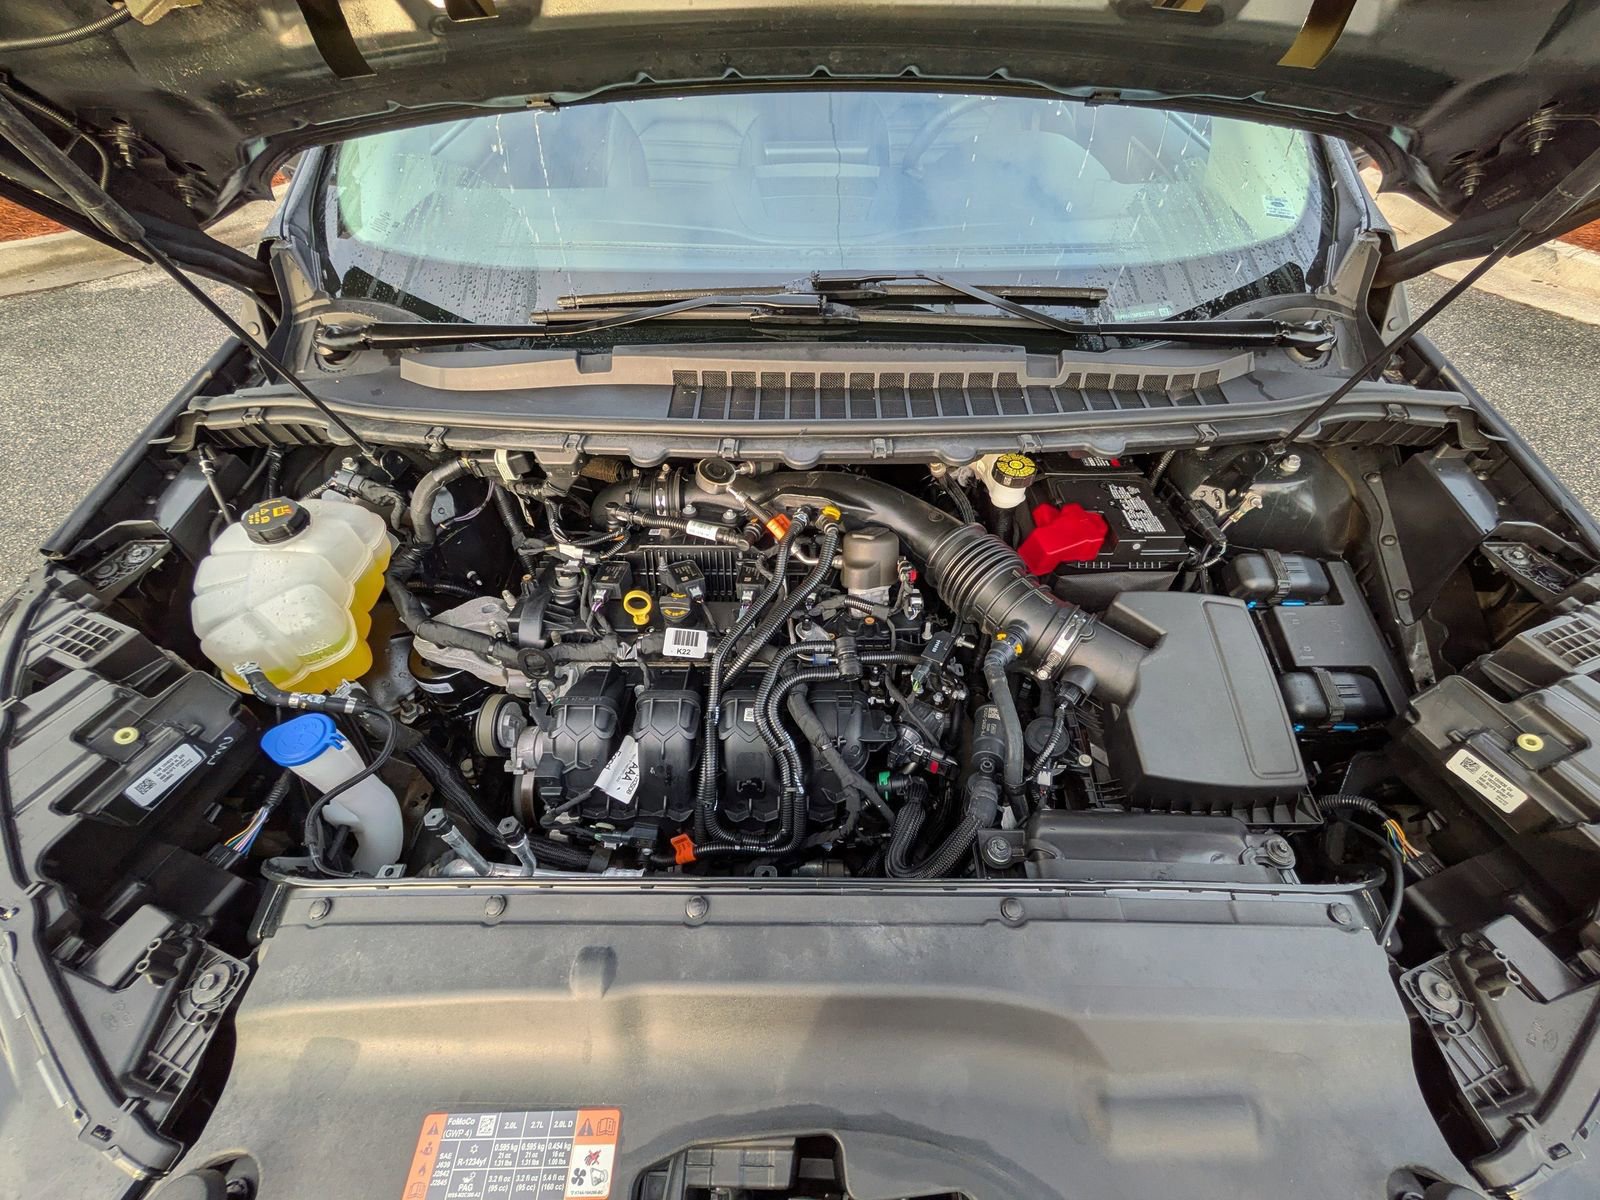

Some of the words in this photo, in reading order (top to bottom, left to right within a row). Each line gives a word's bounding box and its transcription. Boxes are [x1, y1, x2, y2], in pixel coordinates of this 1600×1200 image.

[621, 761, 638, 781] AAA
[448, 1117, 475, 1125] FoMoCo
[443, 1129, 463, 1139] (GWP
[464, 1129, 472, 1139] 4)
[510, 1143, 518, 1152] kg
[537, 1142, 545, 1152] kg
[547, 1142, 563, 1150] 0.454
[563, 1142, 571, 1151] kg
[457, 1157, 487, 1168] R-1234yf
[458, 1184, 474, 1192] PAG
[488, 1185, 498, 1193] (95
[498, 1184, 508, 1192] cc)
[515, 1184, 526, 1193] (95
[526, 1184, 536, 1192] cc)
[554, 1183, 564, 1191] cc)
